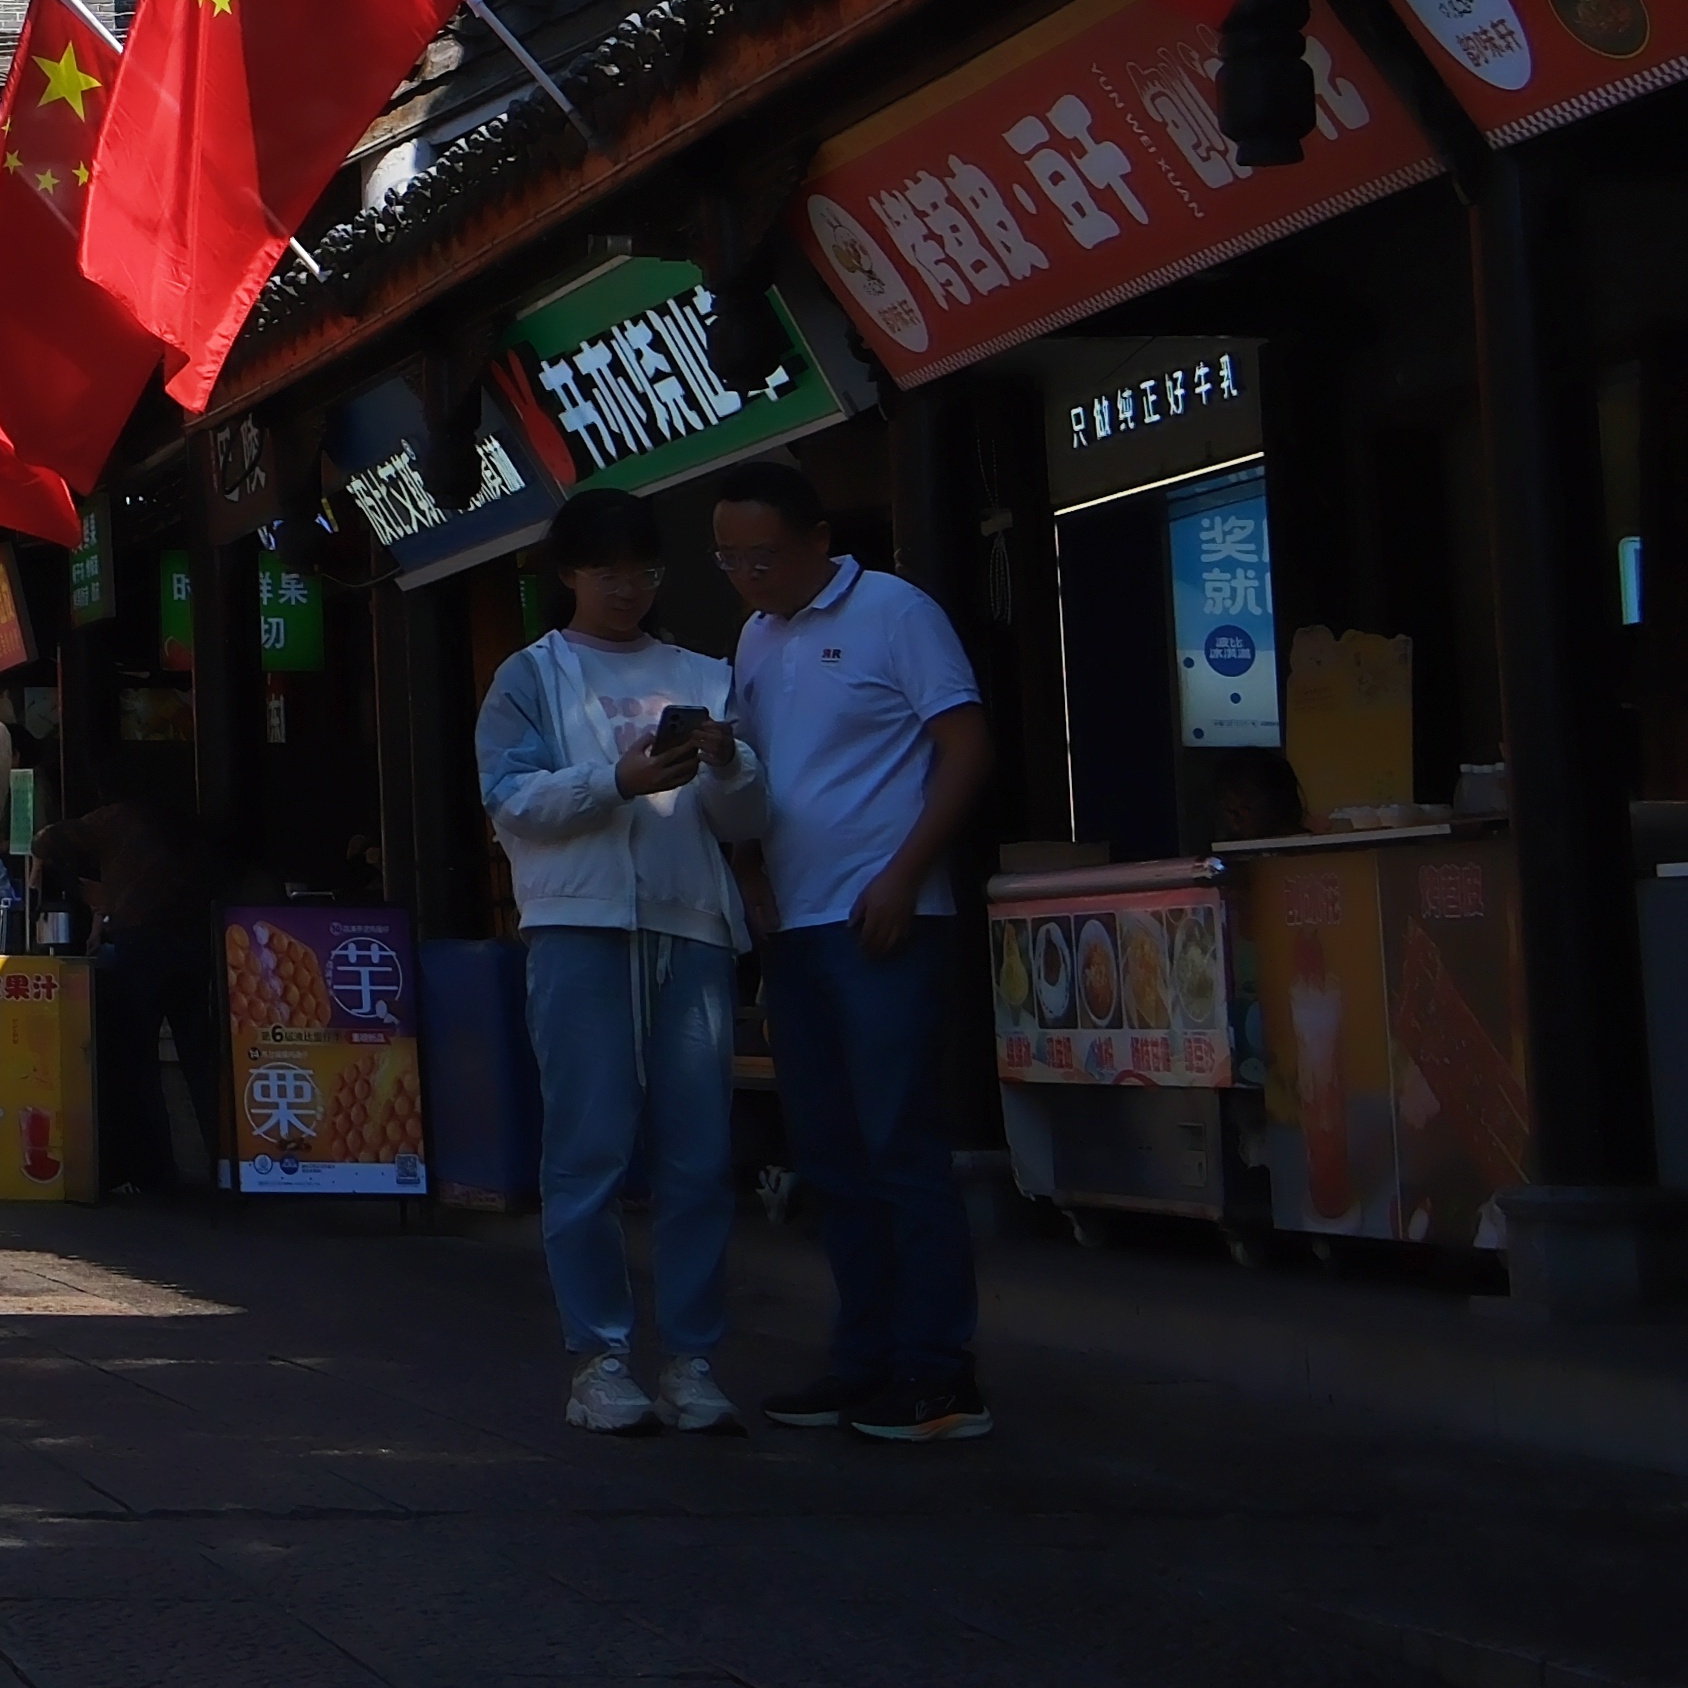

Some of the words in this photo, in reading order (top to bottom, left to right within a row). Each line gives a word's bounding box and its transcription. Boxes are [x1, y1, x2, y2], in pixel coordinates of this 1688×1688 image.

[1089, 62, 1124, 112] YUN
[1124, 113, 1159, 156] WEI
[1155, 156, 1206, 221] XUAN
[538, 284, 791, 470] 书亦烧仙
[1069, 349, 1241, 450] 只做纯正好牛乳
